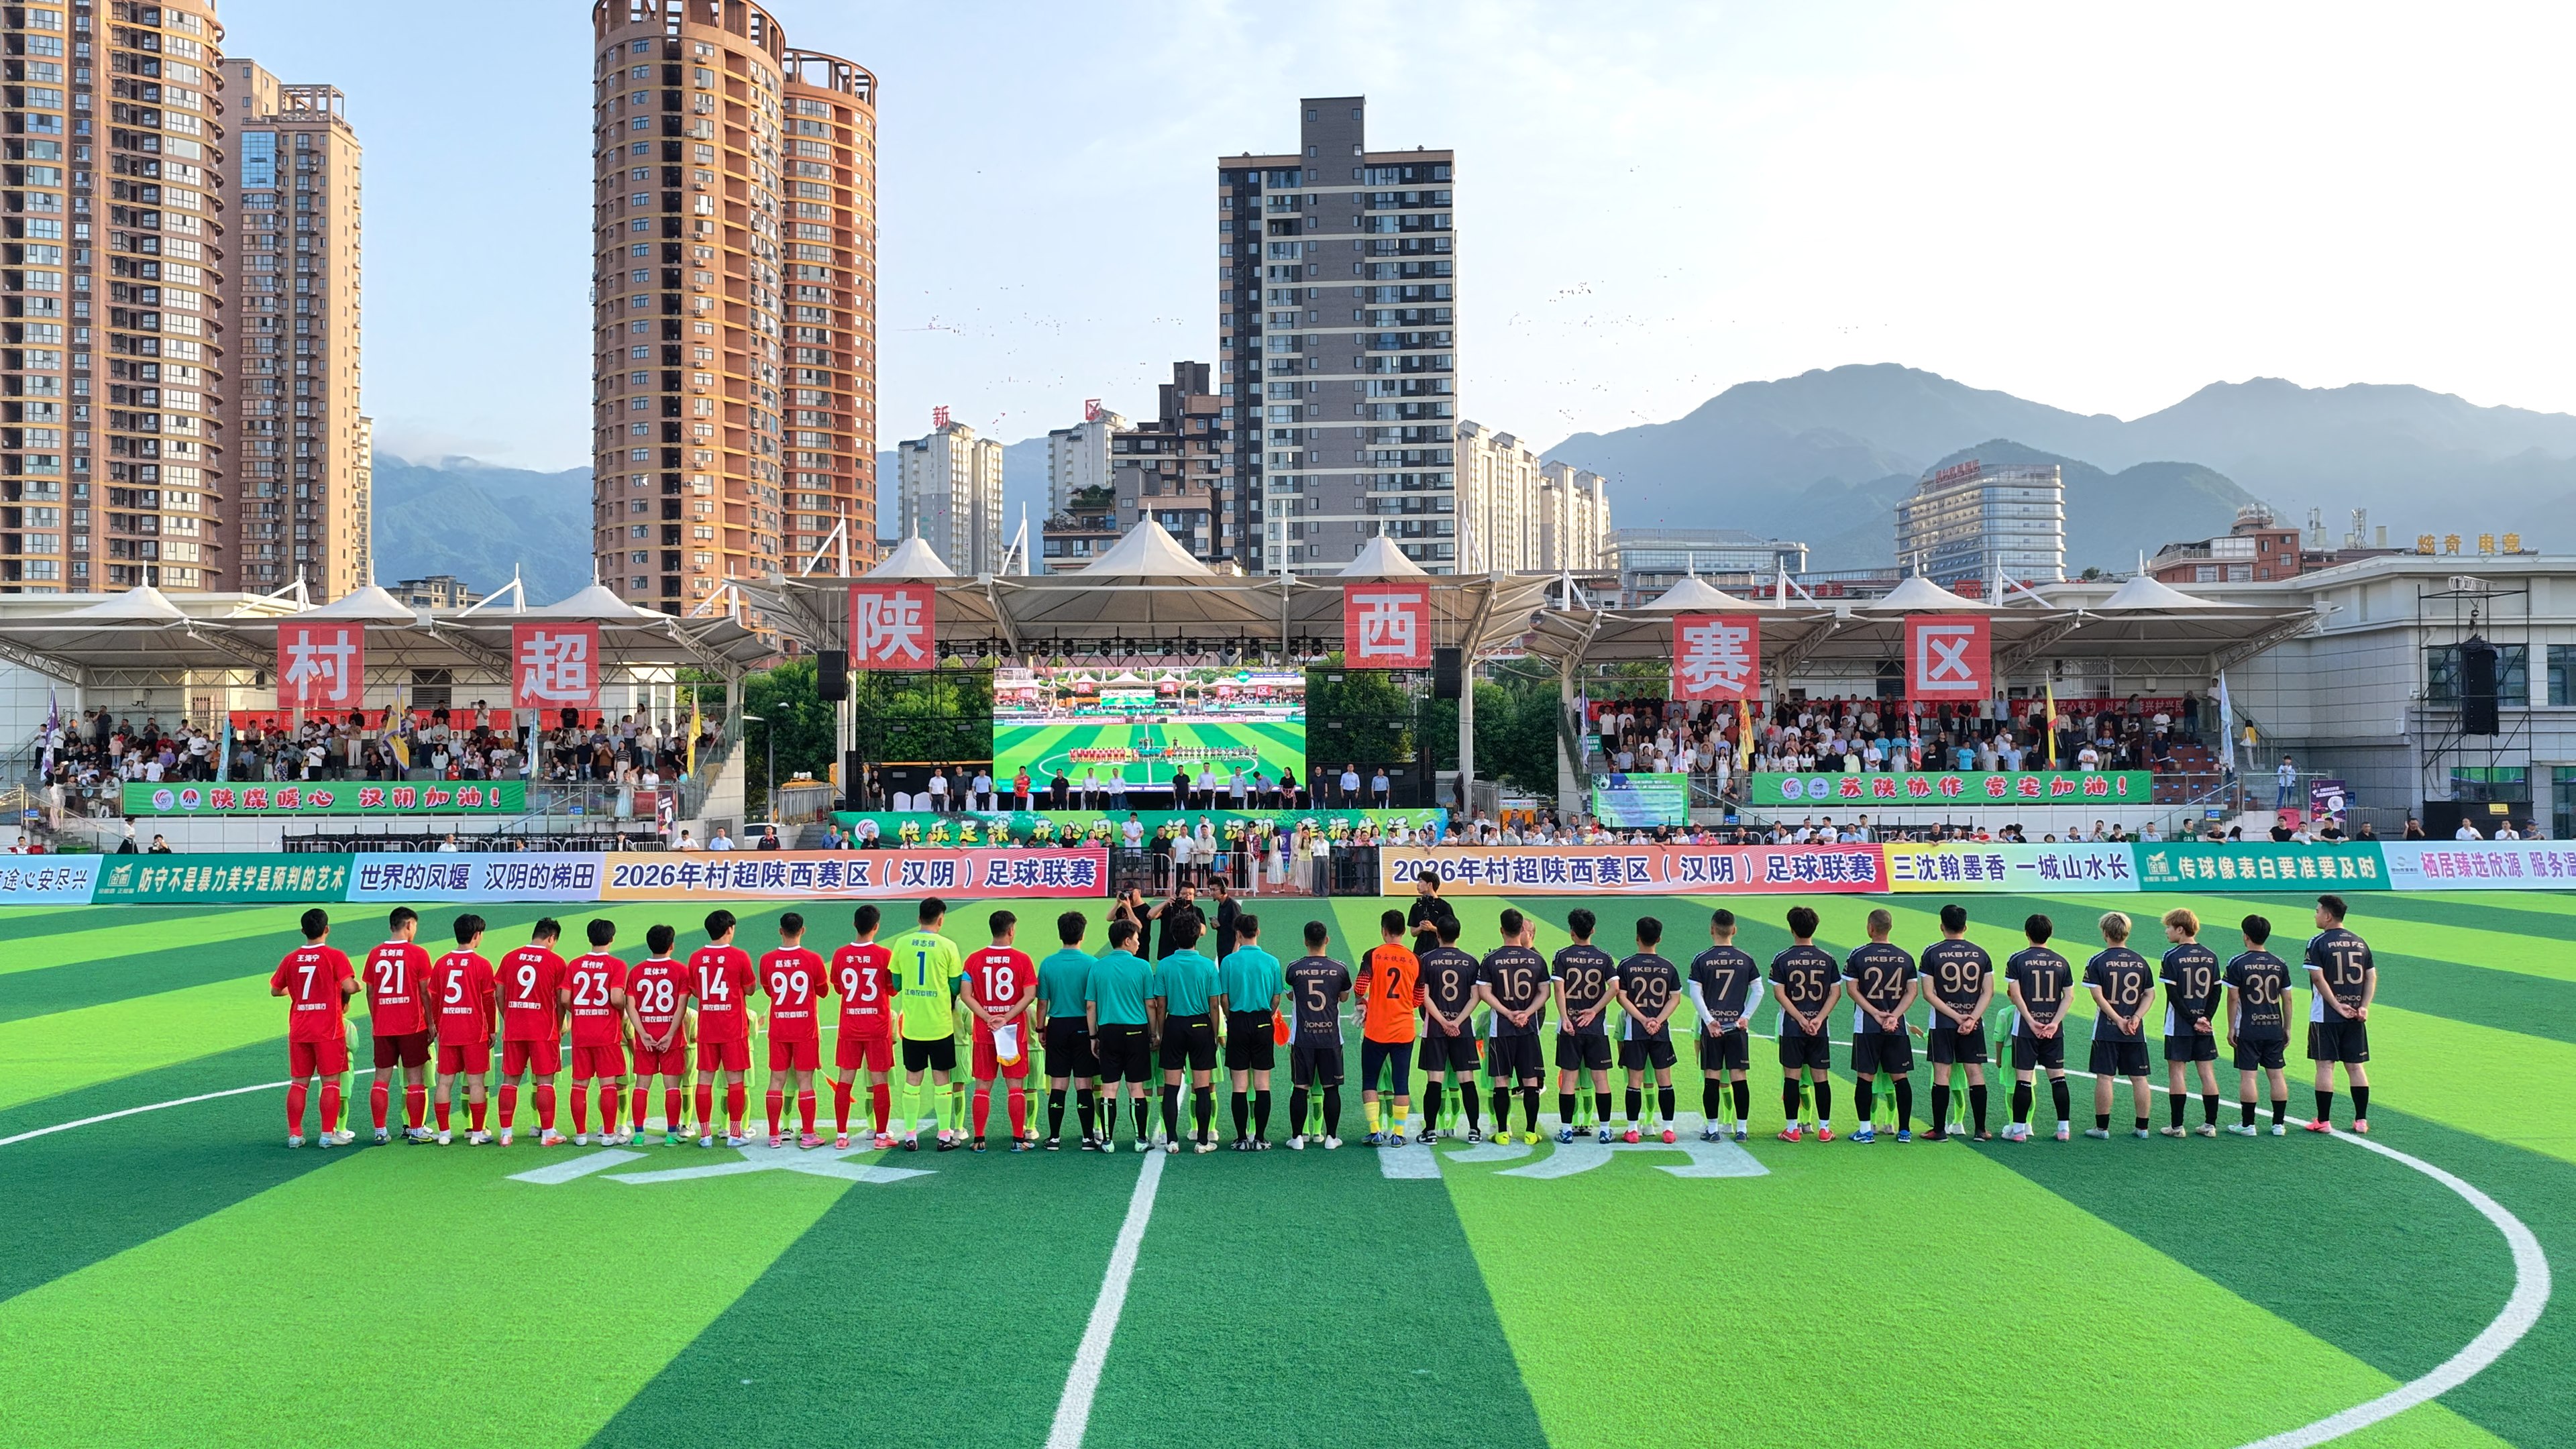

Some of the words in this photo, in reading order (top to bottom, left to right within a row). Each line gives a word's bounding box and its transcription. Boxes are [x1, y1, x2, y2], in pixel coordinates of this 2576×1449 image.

[932, 405, 950, 427] 新
[1085, 398, 1102, 421] 区
[857, 590, 924, 662] 陕
[1351, 593, 1422, 657] 西
[284, 630, 356, 701] 村
[520, 631, 592, 700] 超
[1680, 621, 1752, 694] 赛
[1917, 625, 1978, 690] 区
[211, 788, 335, 810] 陕煤暖心
[358, 786, 502, 809] 汉阴加油！
[1839, 776, 1965, 798] 苏陕协作
[1986, 776, 2127, 797] 常安加油！
[0, 868, 88, 892] 途心安尽兴
[138, 866, 347, 893] 防守不是暴力美学是预判的艺术
[360, 864, 471, 891] 世界的凤堰
[484, 863, 595, 890] 汉阴的梯田
[612, 860, 1096, 889] 2026年村超陕西赛区（汉阴）足球联赛
[1393, 854, 1876, 885] 2026年村超陕西赛区（汉阴）足球联赛
[1894, 856, 2006, 881] 三沈翰墨香
[2016, 854, 2129, 880] 一城山水长
[2178, 855, 2377, 880] 传球像表白要准要及时
[2420, 851, 2524, 878] 栖居臻选欣源
[298, 965, 317, 1000] 7
[375, 960, 405, 994] 21
[517, 965, 536, 999] 9
[698, 966, 729, 1001] 14
[916, 951, 926, 985] 1
[982, 966, 1014, 1001] 18
[1387, 967, 1400, 998] 2
[1566, 967, 1602, 1000] 28
[1715, 969, 1735, 1000] 7
[1864, 967, 1902, 1000] 24
[1941, 961, 1980, 993] 99
[2183, 967, 2211, 999] 19
[2332, 951, 2363, 985] 15
[444, 969, 463, 1004] 5
[574, 971, 609, 1006] 23
[637, 979, 674, 1013] 28
[771, 970, 809, 1006] 99
[841, 968, 878, 1002] 93
[1307, 979, 1327, 1012] 5
[1442, 969, 1458, 1002] 8
[1498, 969, 1533, 1001] 16
[1631, 977, 1667, 1008] 29
[1789, 969, 1825, 1002] 35
[2031, 969, 2056, 1002] 11
[2107, 971, 2141, 1005] 18
[2246, 974, 2280, 1004] 30
